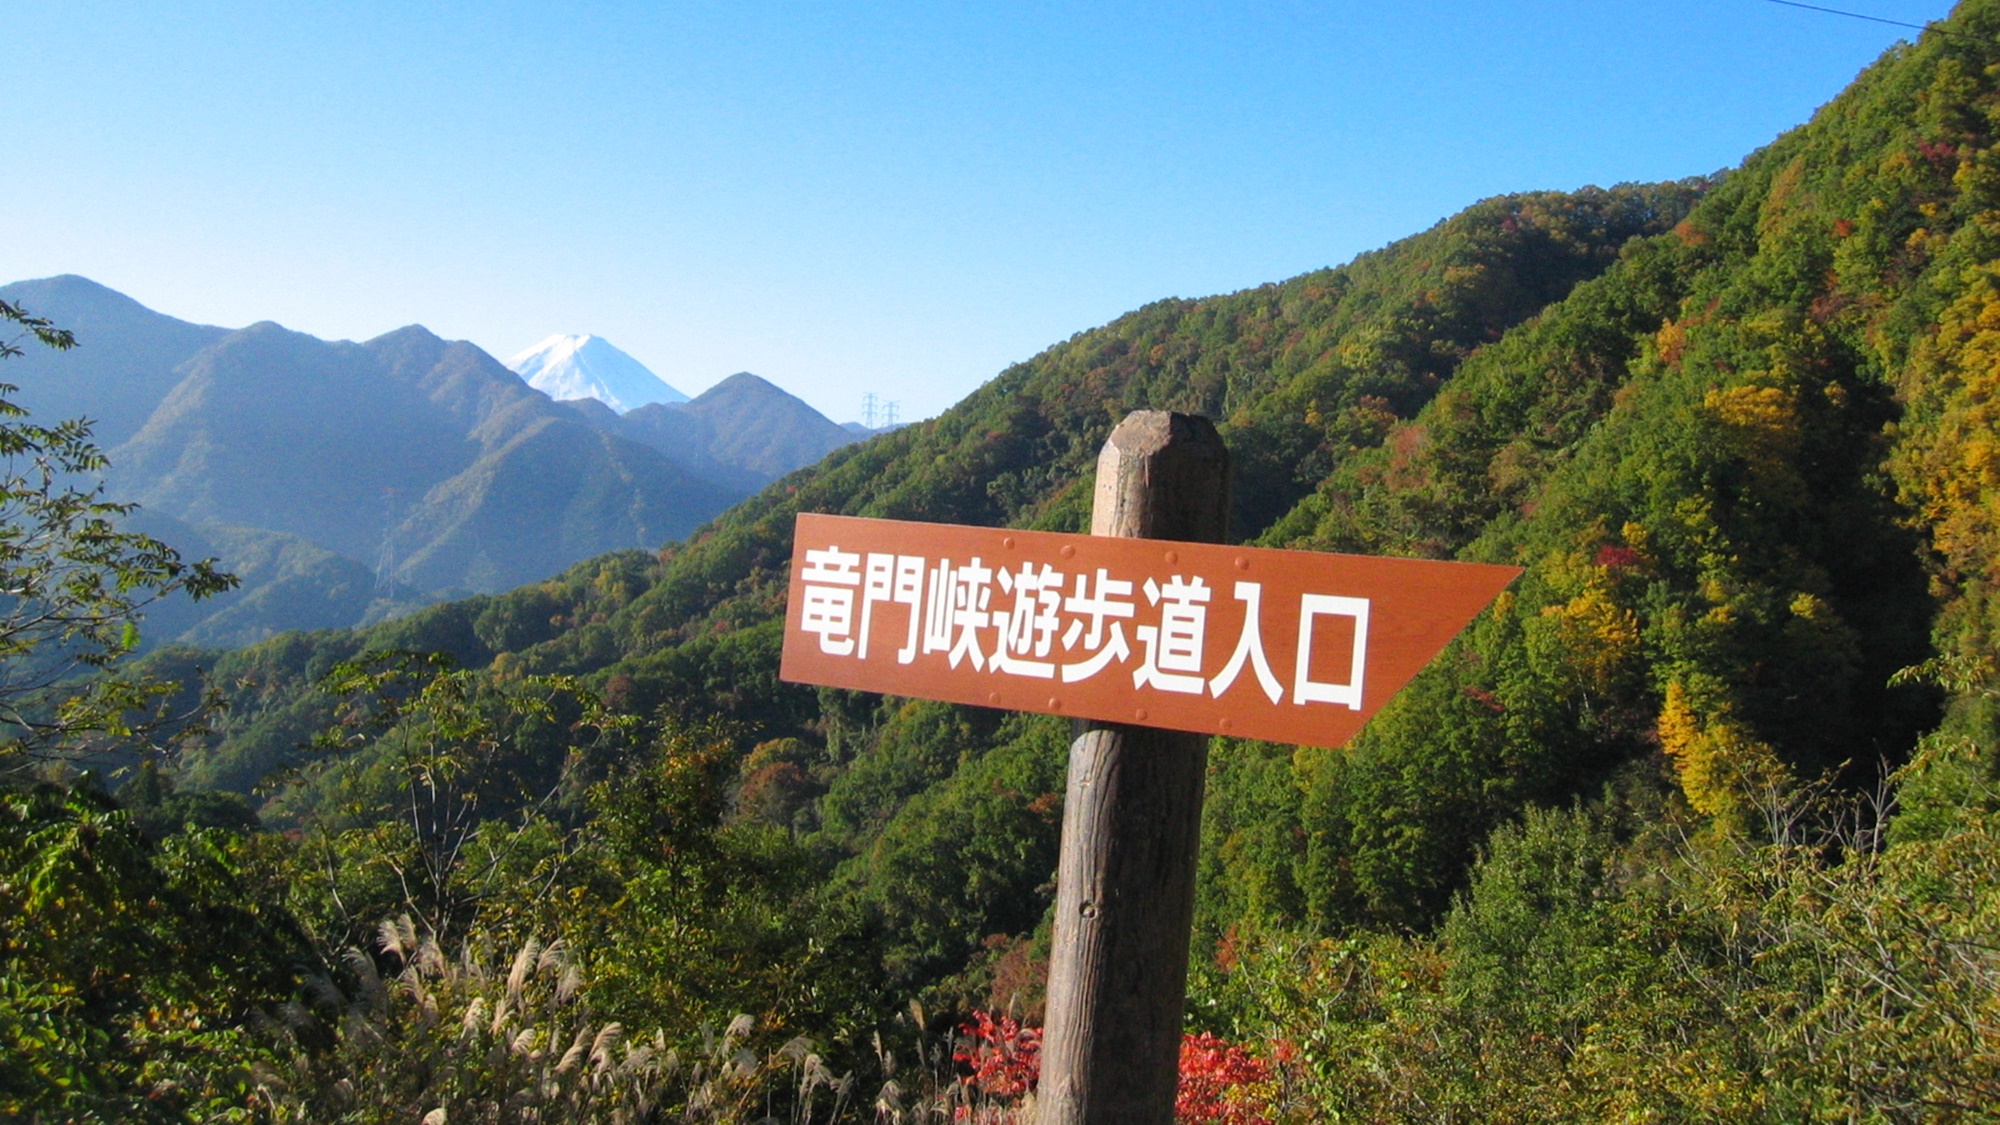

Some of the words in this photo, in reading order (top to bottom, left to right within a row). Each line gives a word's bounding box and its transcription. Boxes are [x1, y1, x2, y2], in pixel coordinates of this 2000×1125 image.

[800, 545, 1370, 711] 竜門峡遊歩道入口
